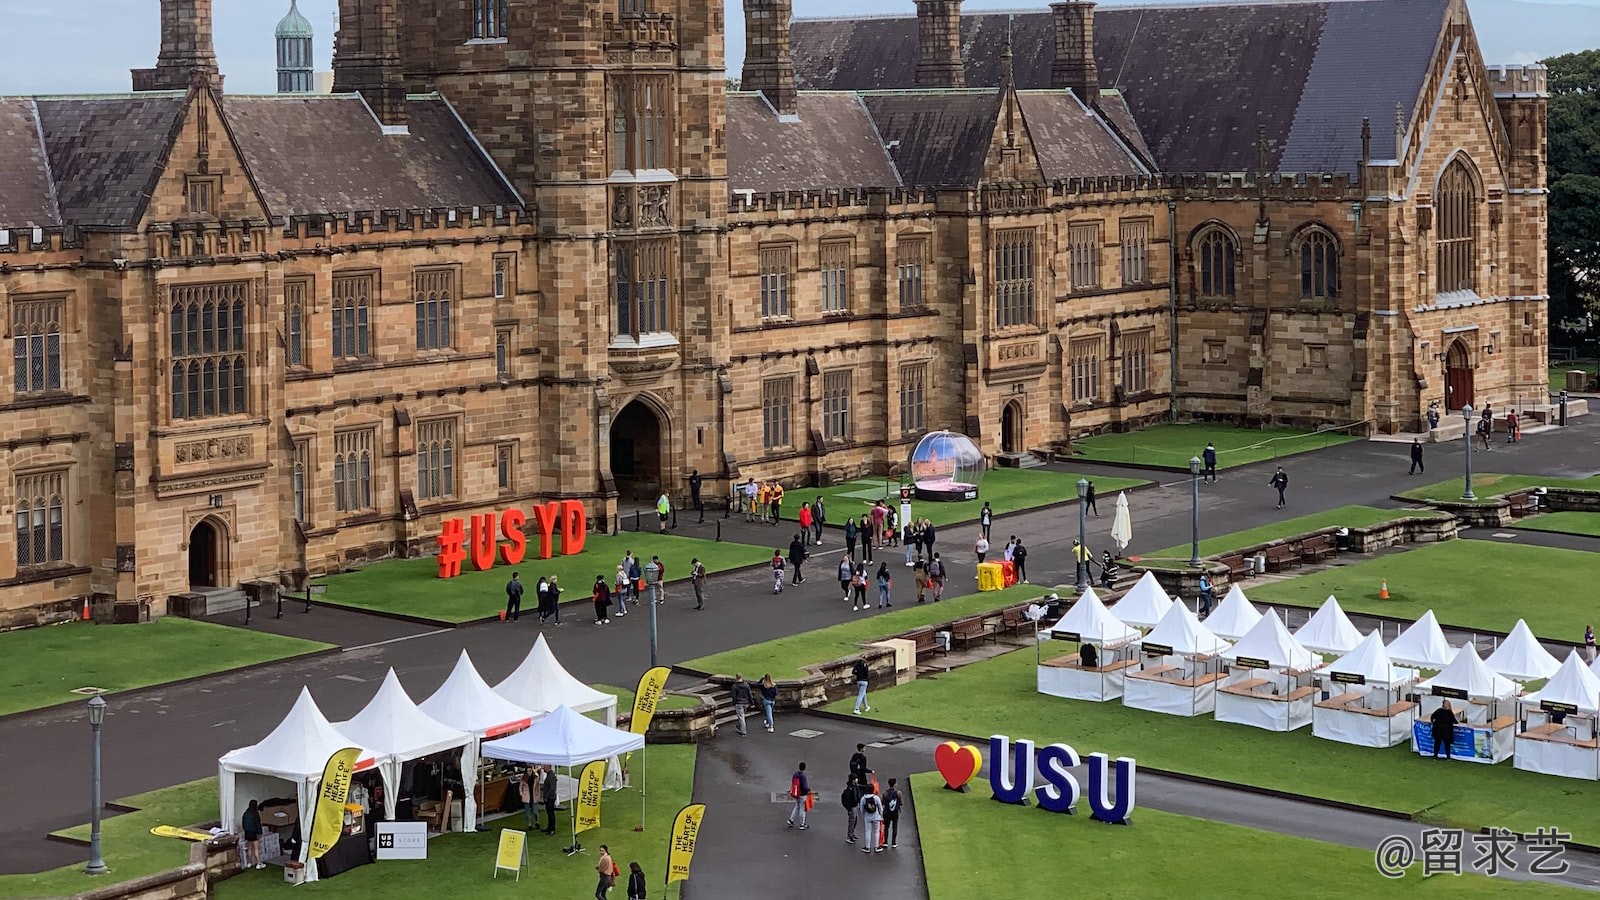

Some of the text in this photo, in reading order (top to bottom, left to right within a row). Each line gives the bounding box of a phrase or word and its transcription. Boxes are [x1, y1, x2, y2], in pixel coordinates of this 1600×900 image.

[436, 498, 587, 578] #USYD
[640, 676, 656, 712] HEART OF
[646, 684, 660, 714] UNI LIFE
[323, 782, 334, 799] THE
[330, 759, 345, 803] HEART OF
[336, 768, 350, 804] UNI LIFE
[580, 790, 588, 804] THE
[586, 769, 596, 806] HEART OF
[989, 734, 1136, 824] USU
[675, 835, 683, 851] THE
[681, 813, 692, 852] HEART OF
